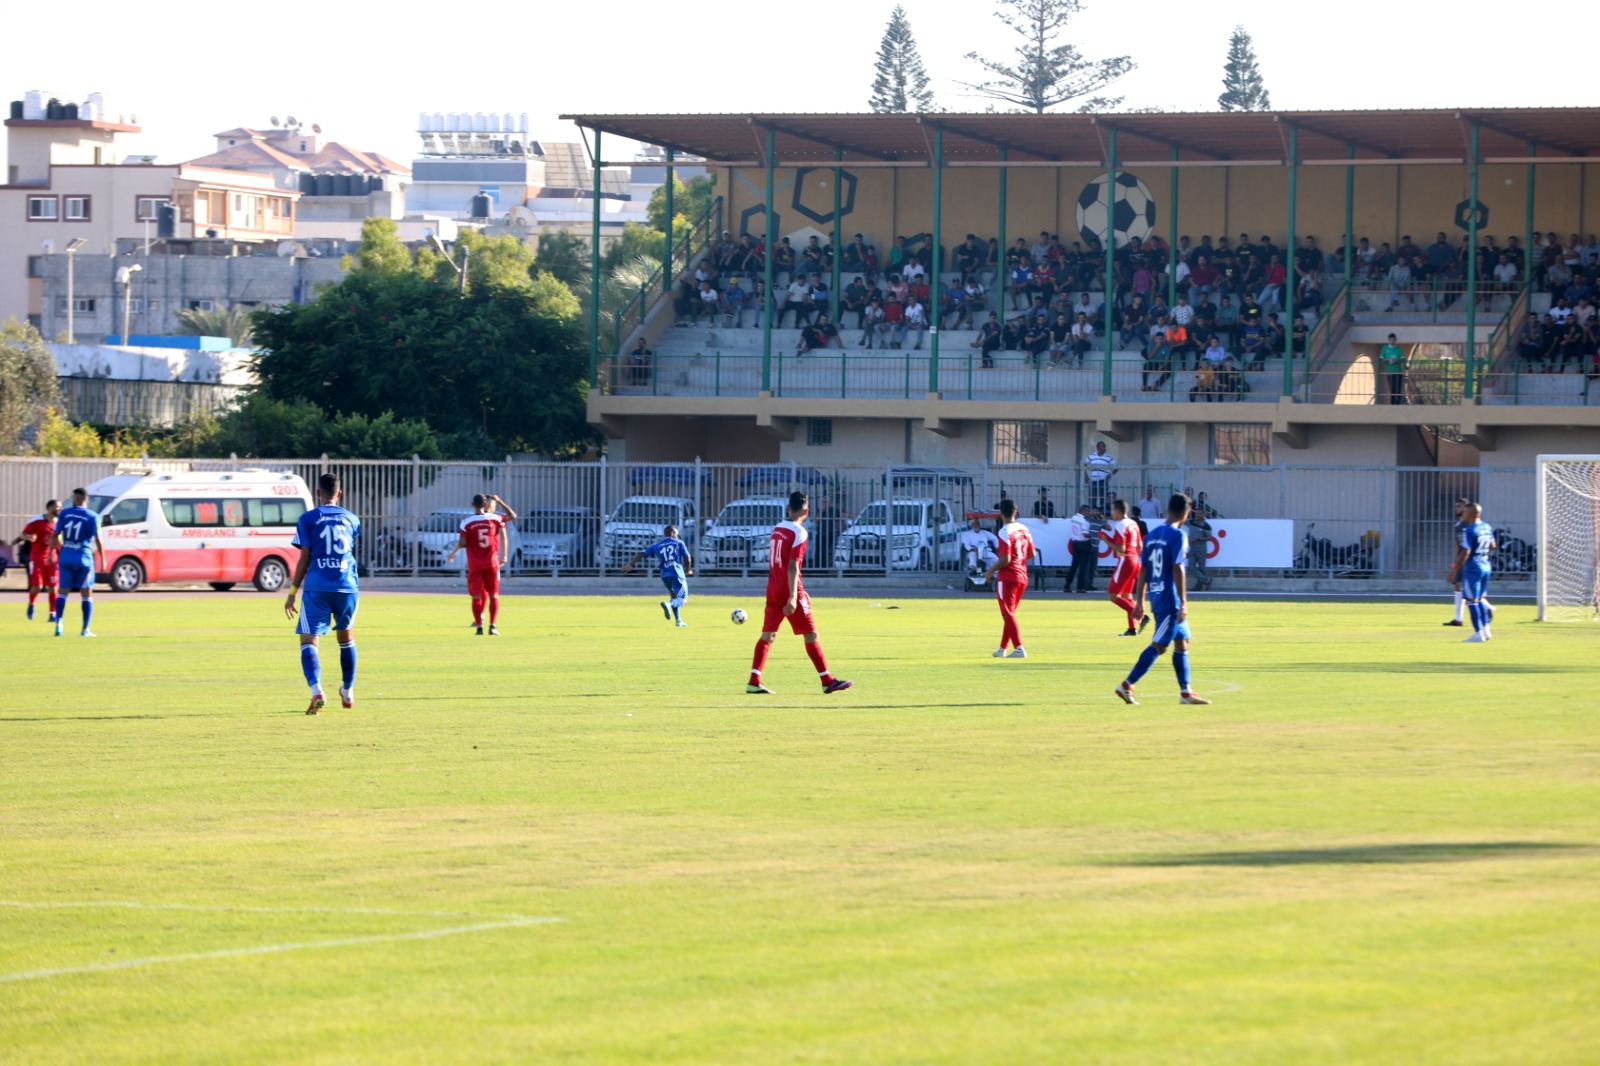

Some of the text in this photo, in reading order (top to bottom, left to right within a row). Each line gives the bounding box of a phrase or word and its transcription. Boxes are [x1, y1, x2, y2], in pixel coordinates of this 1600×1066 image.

[271, 485, 299, 495] 1203
[64, 520, 82, 541] 11
[182, 528, 237, 538] AMBULANCE
[319, 524, 351, 555] 15
[477, 528, 490, 549] 5
[659, 545, 675, 562] 12
[1148, 548, 1164, 578] 19
